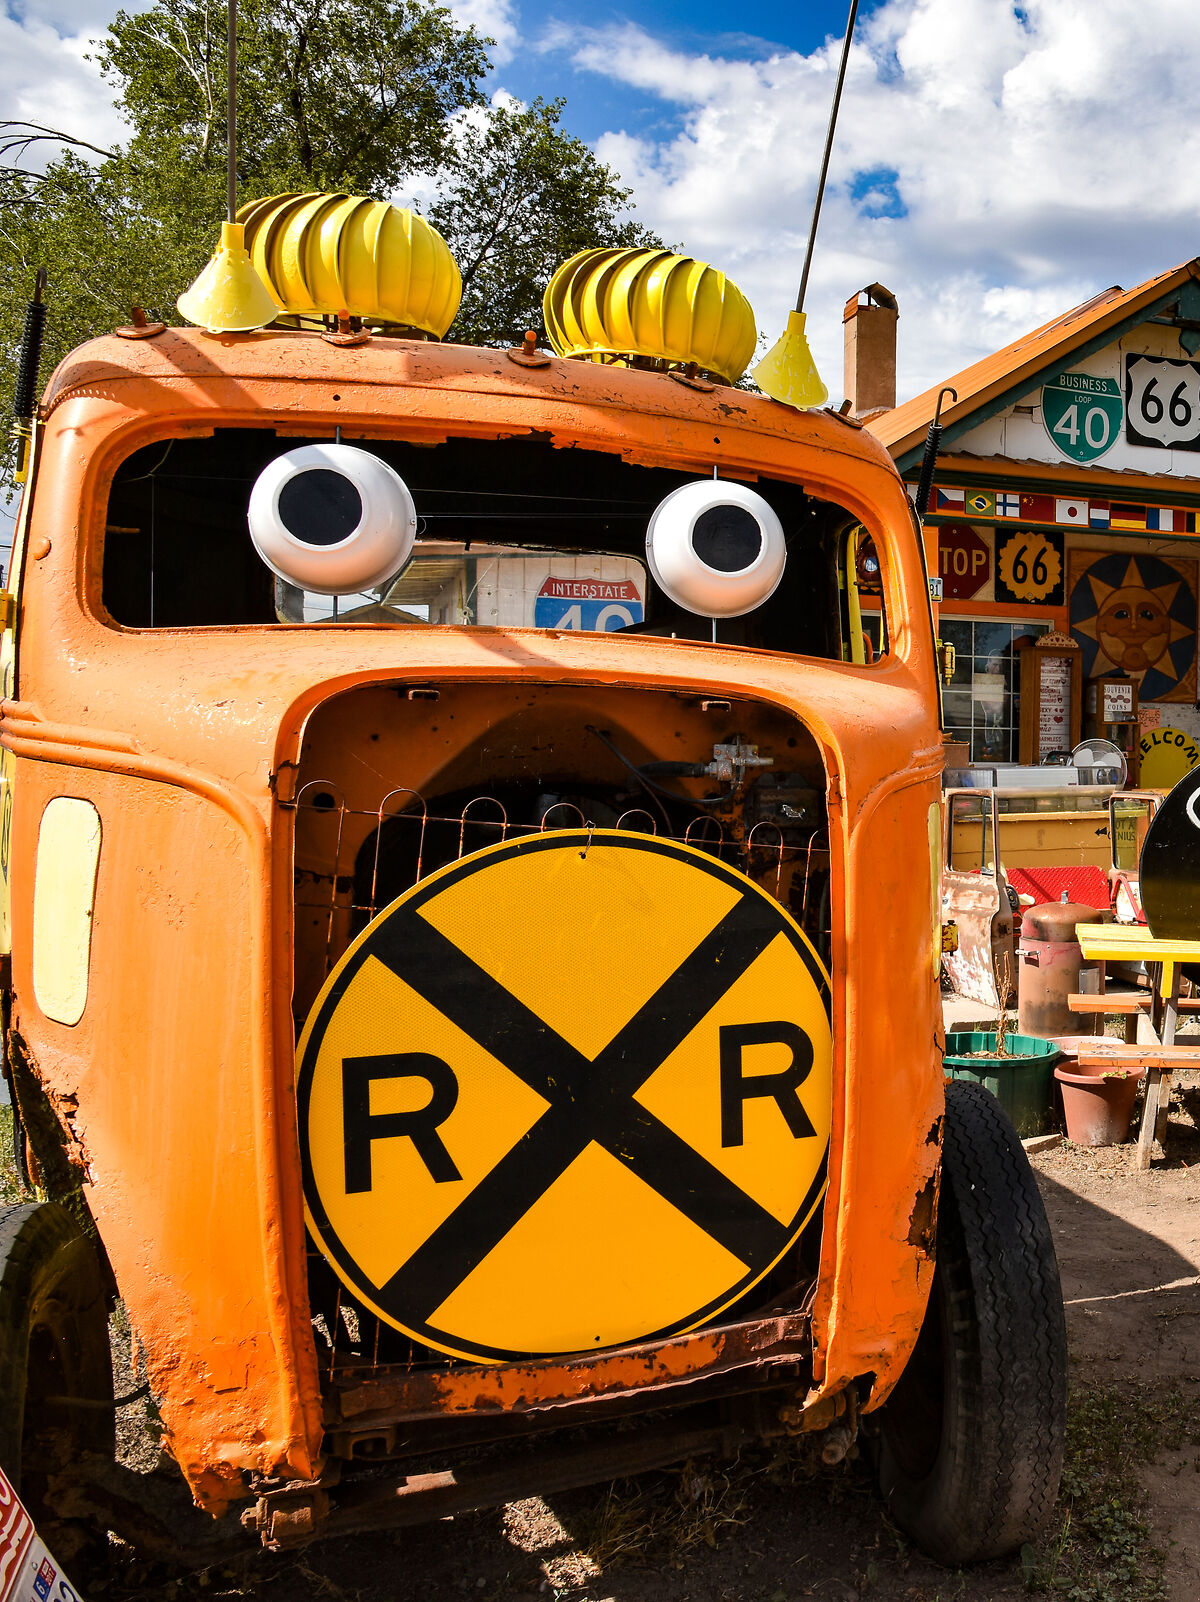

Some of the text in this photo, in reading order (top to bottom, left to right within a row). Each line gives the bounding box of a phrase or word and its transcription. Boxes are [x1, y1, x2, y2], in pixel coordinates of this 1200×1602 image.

[1060, 375, 1107, 392] BUSINESS
[1074, 395, 1092, 403] LOOP
[1141, 376, 1192, 427] 66
[1053, 404, 1110, 449] 40
[939, 547, 986, 576] TOP
[1012, 545, 1048, 586] 66
[551, 581, 629, 600] INTERSTATE
[1139, 731, 1199, 769] ELCOM
[342, 1020, 817, 1195] R R
